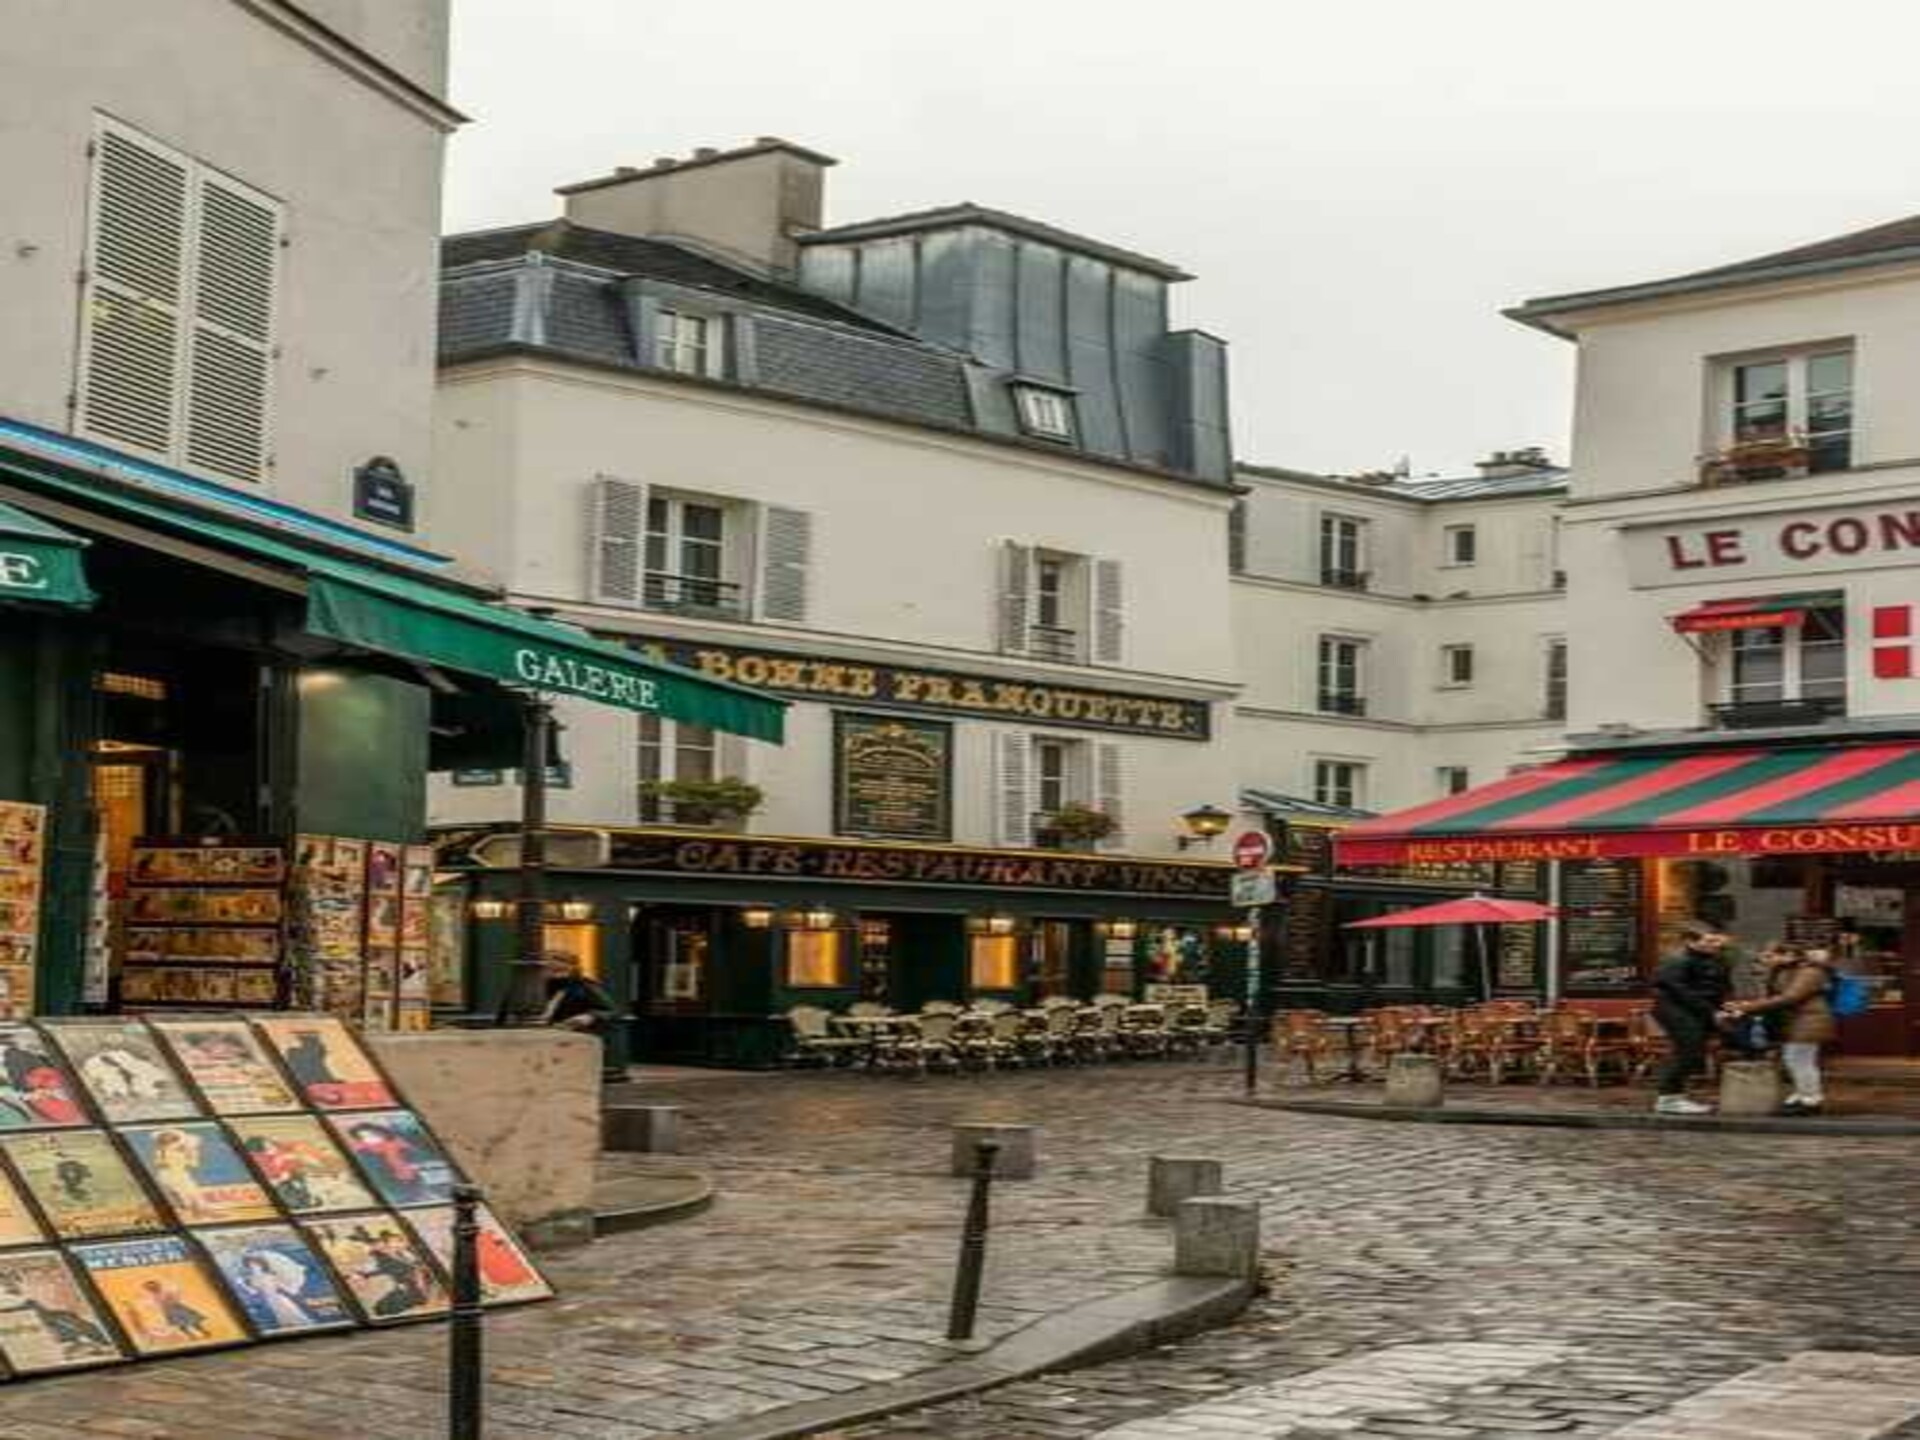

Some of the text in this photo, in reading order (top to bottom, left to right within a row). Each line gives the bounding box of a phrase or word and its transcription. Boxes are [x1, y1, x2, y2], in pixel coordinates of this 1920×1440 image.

[1665, 511, 1920, 570] LE CON
[514, 648, 661, 709] GALERIE
[1408, 834, 1603, 862] RESTAURANT
[1687, 830, 1742, 853] LE
